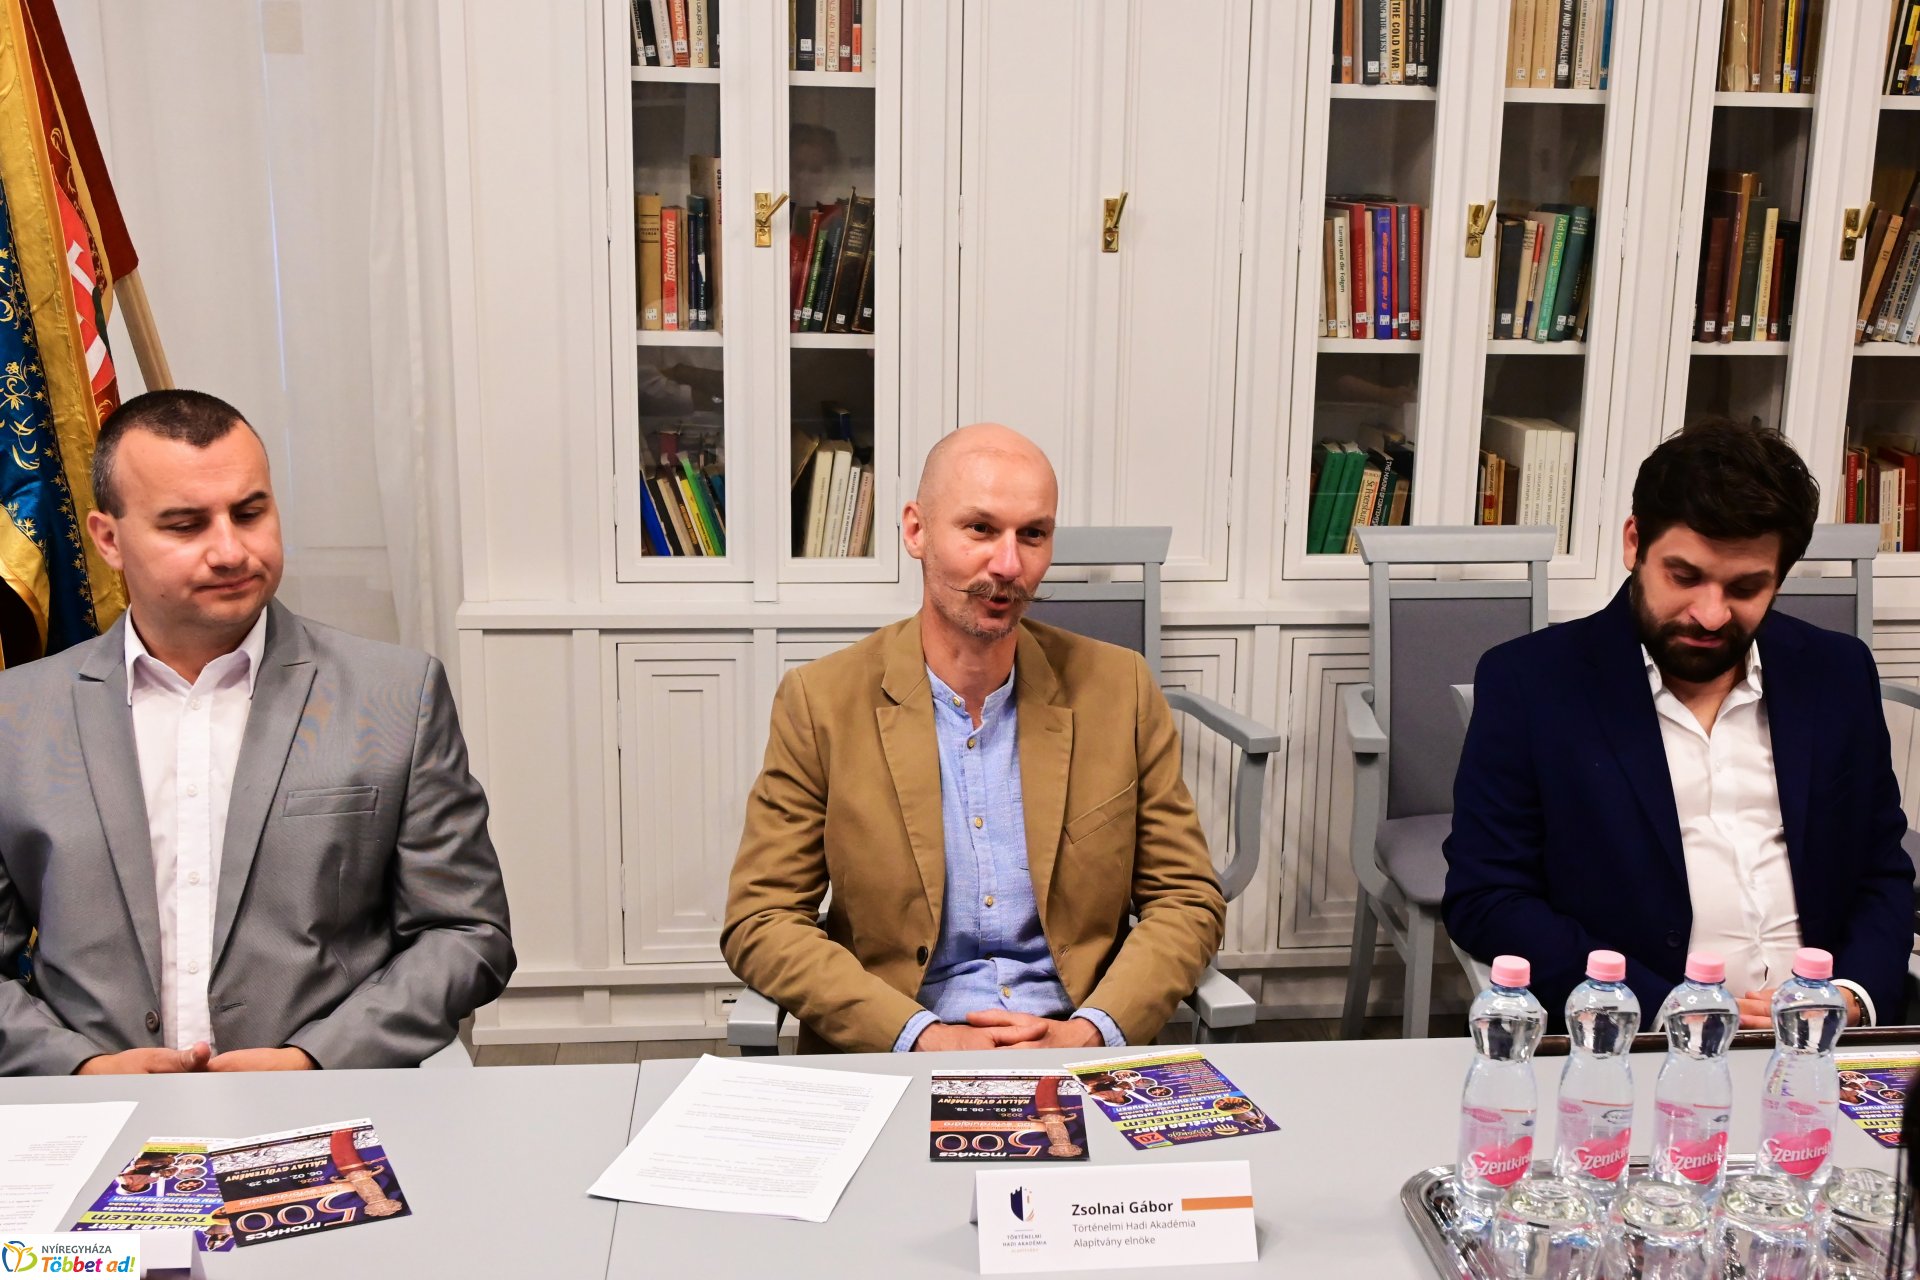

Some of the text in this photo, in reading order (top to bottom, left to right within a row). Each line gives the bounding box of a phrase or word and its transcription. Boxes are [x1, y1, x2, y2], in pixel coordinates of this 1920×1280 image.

[1562, 13, 1571, 27] AND
[1391, 2, 1401, 69] THE COLD WAR
[1560, 28, 1570, 65] JERUSALEM
[1557, 217, 1566, 231] Aid
[664, 218, 676, 282] Tisztító vihar
[1552, 241, 1562, 267] Russia
[1384, 461, 1392, 471] THE
[935, 1130, 1043, 1157] 500
[290, 1160, 328, 1171] KÁLLAY
[236, 1191, 357, 1232] 500
[1071, 1200, 1174, 1216] Zsolnai Gábor
[1072, 1219, 1196, 1233] Történelmi Hadi Akadémia
[1073, 1235, 1156, 1249] Alapítvány elnöke
